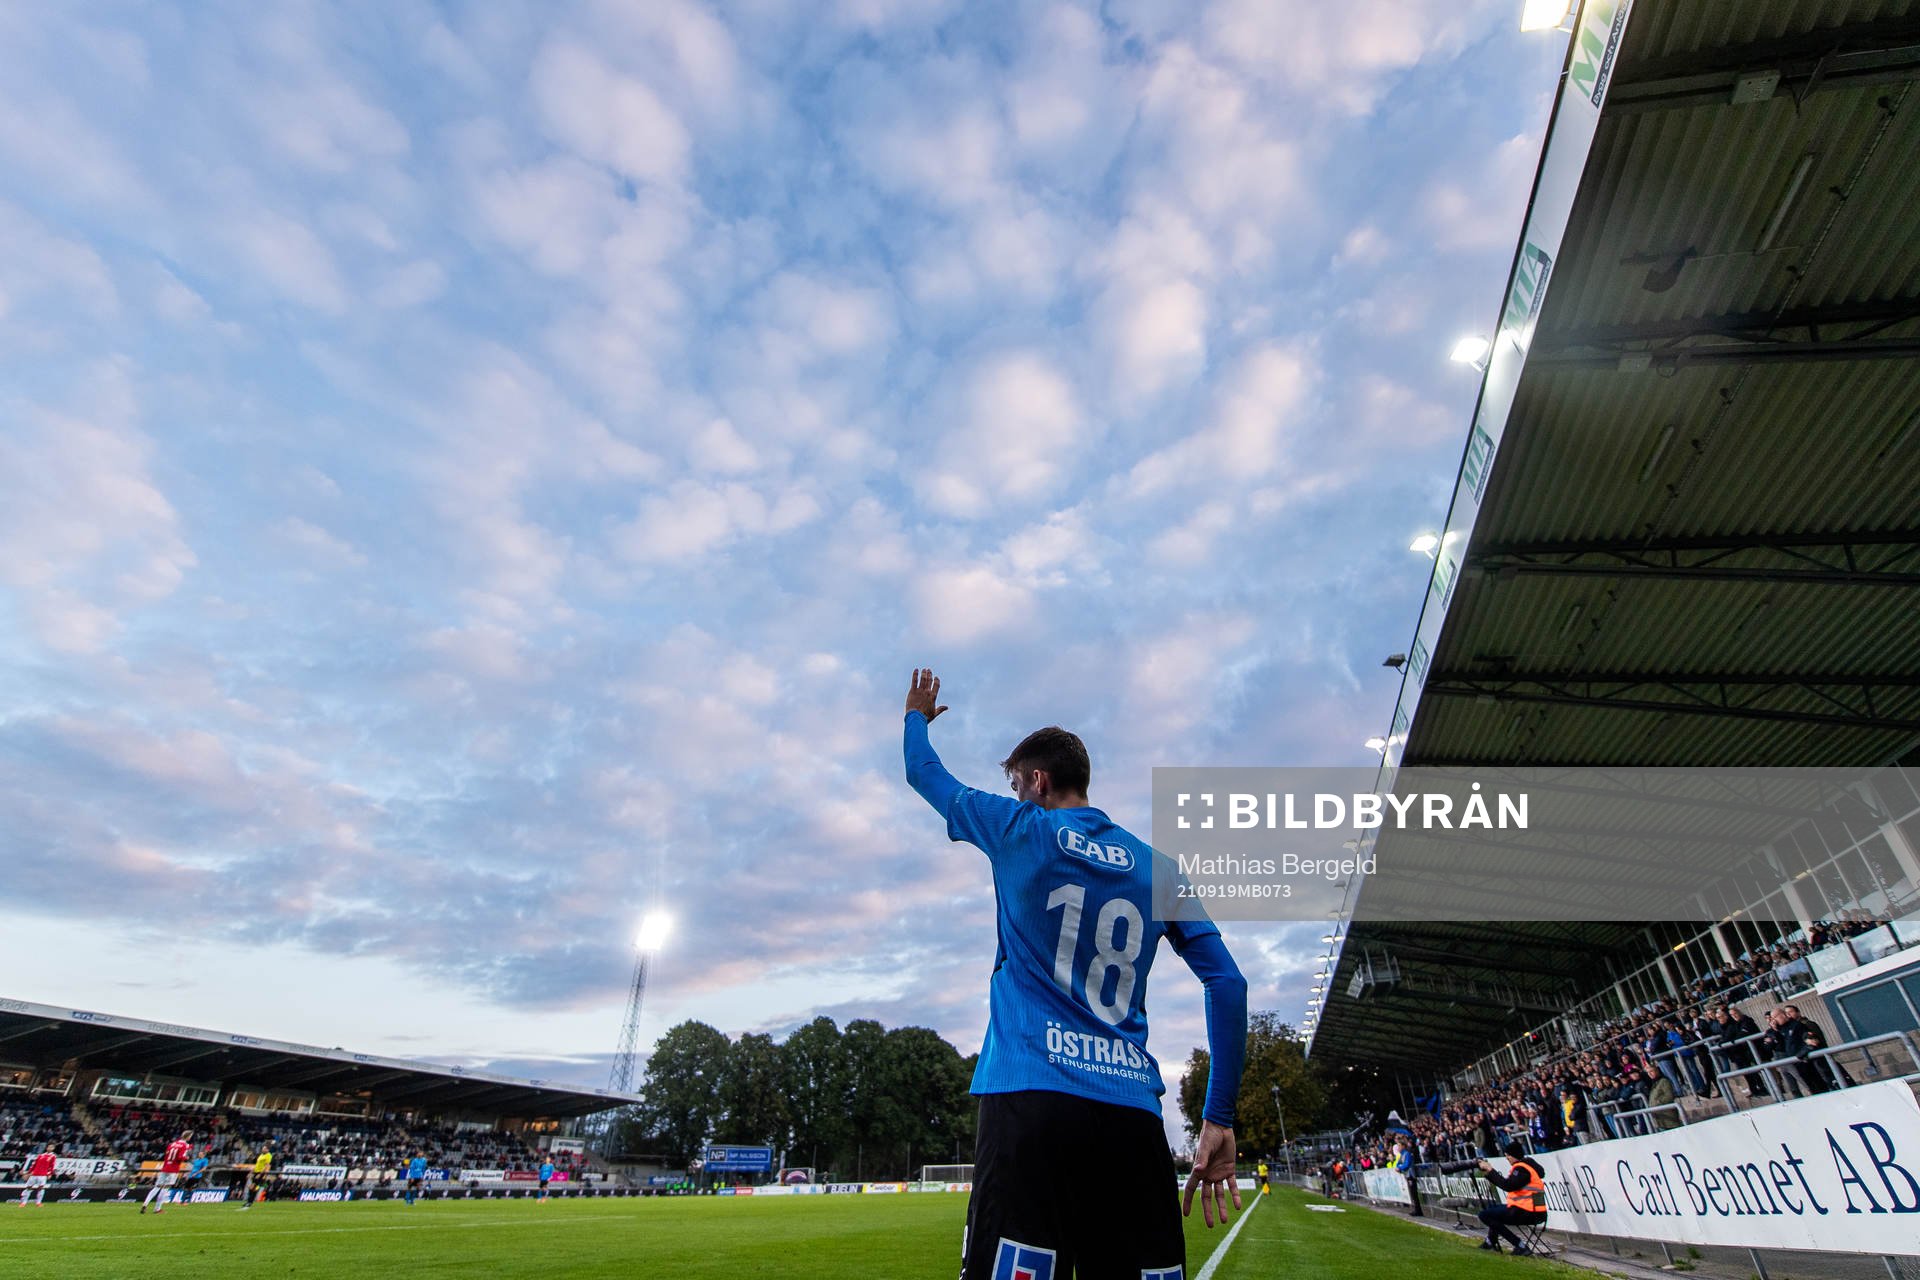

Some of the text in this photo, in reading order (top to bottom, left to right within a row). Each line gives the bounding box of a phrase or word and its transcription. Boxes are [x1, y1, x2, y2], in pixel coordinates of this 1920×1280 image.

[1604, 46, 1616, 69] och
[1065, 829, 1129, 867] EAB
[1046, 883, 1144, 1026] 18
[1048, 1053, 1151, 1084] STENUGNSBAGERIET
[168, 1147, 179, 1160] 11
[1617, 1121, 1920, 1217] Carl Bennet AB
[300, 1191, 342, 1201] HALMSTAD
[1543, 1171, 1580, 1214] nnet
[1574, 1164, 1606, 1214] AB
